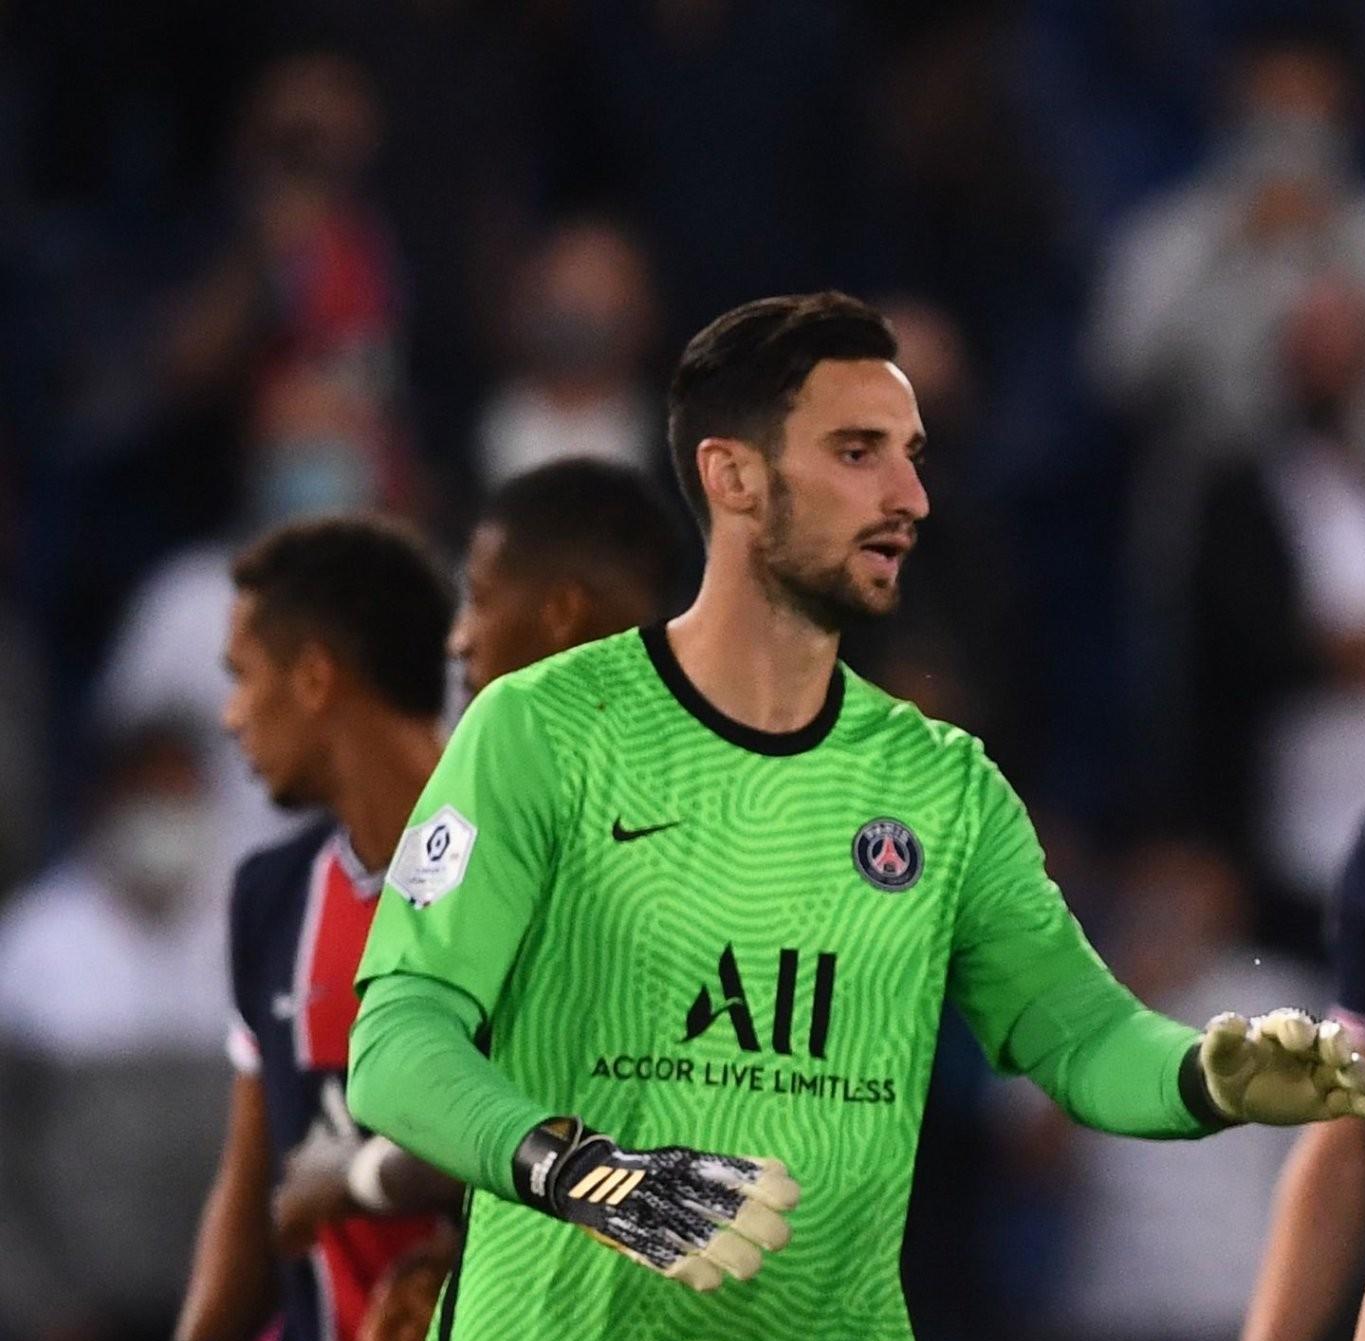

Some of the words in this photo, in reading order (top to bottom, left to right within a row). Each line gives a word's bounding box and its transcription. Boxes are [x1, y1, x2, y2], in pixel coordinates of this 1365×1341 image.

[592, 1055, 694, 1082] ACCOR
[705, 1062, 763, 1091] LIVE
[774, 1070, 895, 1104] LIMITLESS
